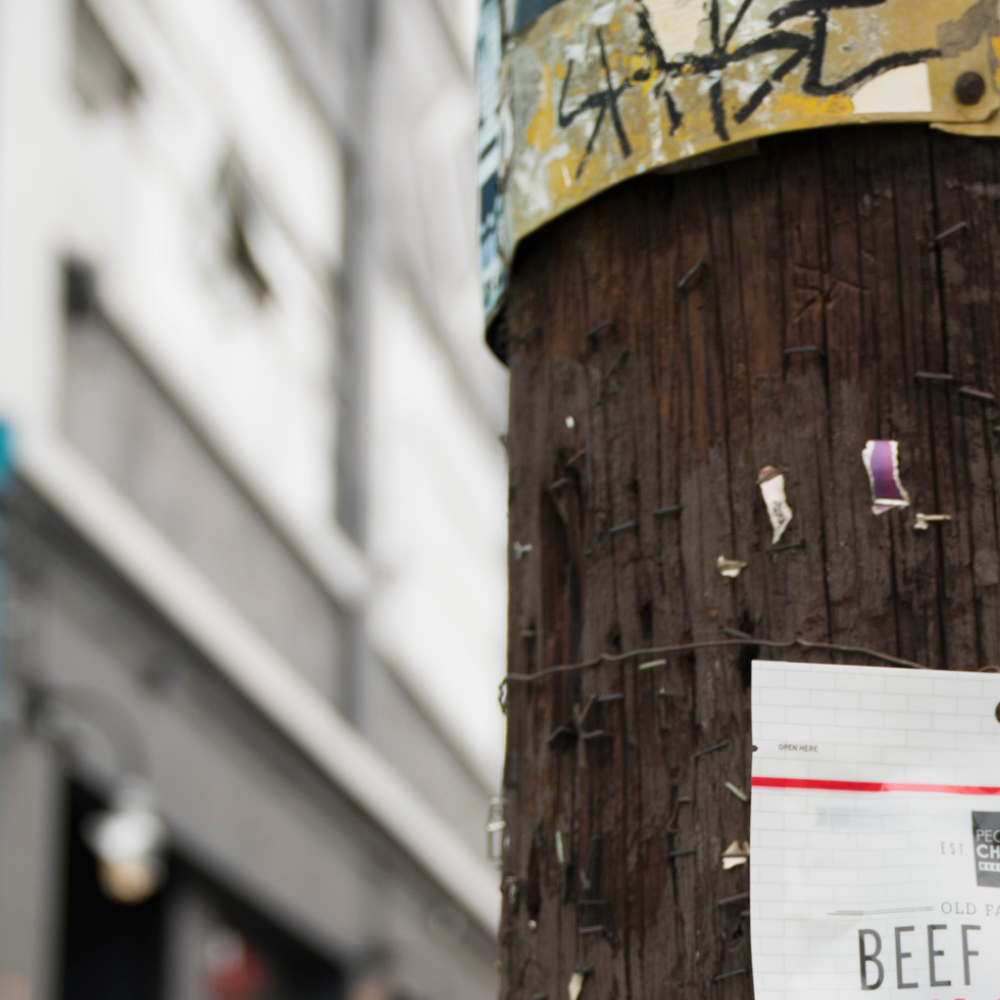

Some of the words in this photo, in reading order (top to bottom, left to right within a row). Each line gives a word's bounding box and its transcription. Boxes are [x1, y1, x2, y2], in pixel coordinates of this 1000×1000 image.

[778, 743, 797, 752] OPEN
[799, 744, 818, 753] HERE
[941, 842, 967, 856] EST.
[941, 901, 977, 915] OLD
[858, 924, 981, 991] BEEF
